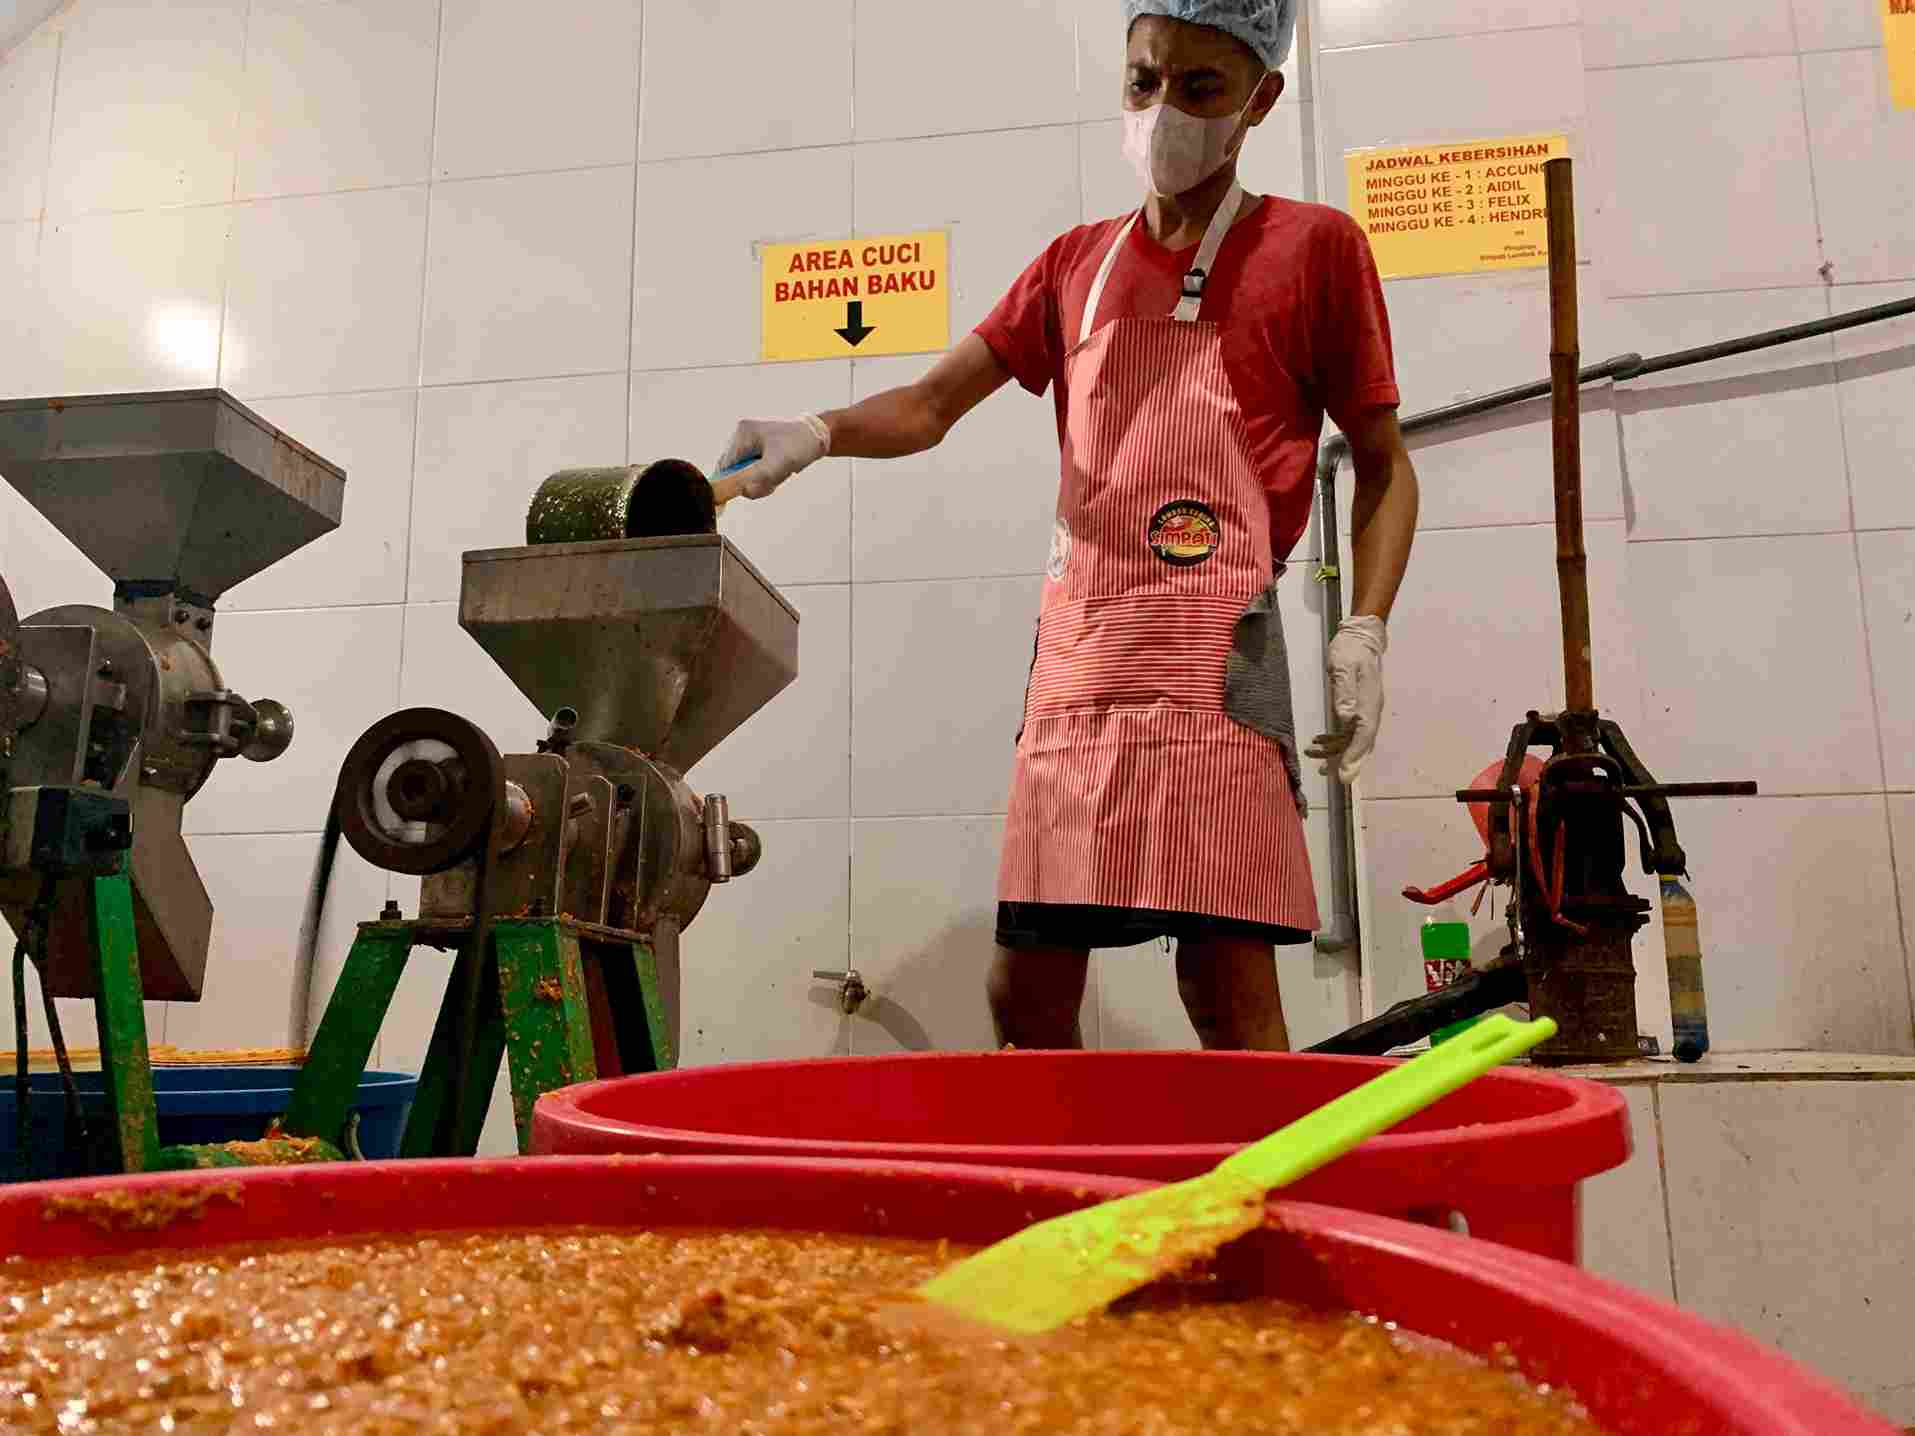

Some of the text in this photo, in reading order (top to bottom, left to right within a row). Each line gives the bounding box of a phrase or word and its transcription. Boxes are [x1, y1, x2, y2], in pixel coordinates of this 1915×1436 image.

[1366, 143, 1549, 171] JADWAL KEBERSIHAN
[1366, 174, 1426, 190] MINGGU
[1431, 171, 1451, 184] KE
[1367, 188, 1427, 204] MINGGU
[1432, 185, 1452, 198] KE
[1487, 179, 1526, 193] AIDIL
[1368, 203, 1428, 219] MINGGU
[1433, 200, 1453, 213] KE
[1488, 194, 1531, 208] FELIX
[1369, 218, 1429, 234] MINGGU
[1434, 216, 1454, 228] KE
[788, 242, 920, 273] AREA CUCI
[775, 269, 936, 302] BAHAN BAKU
